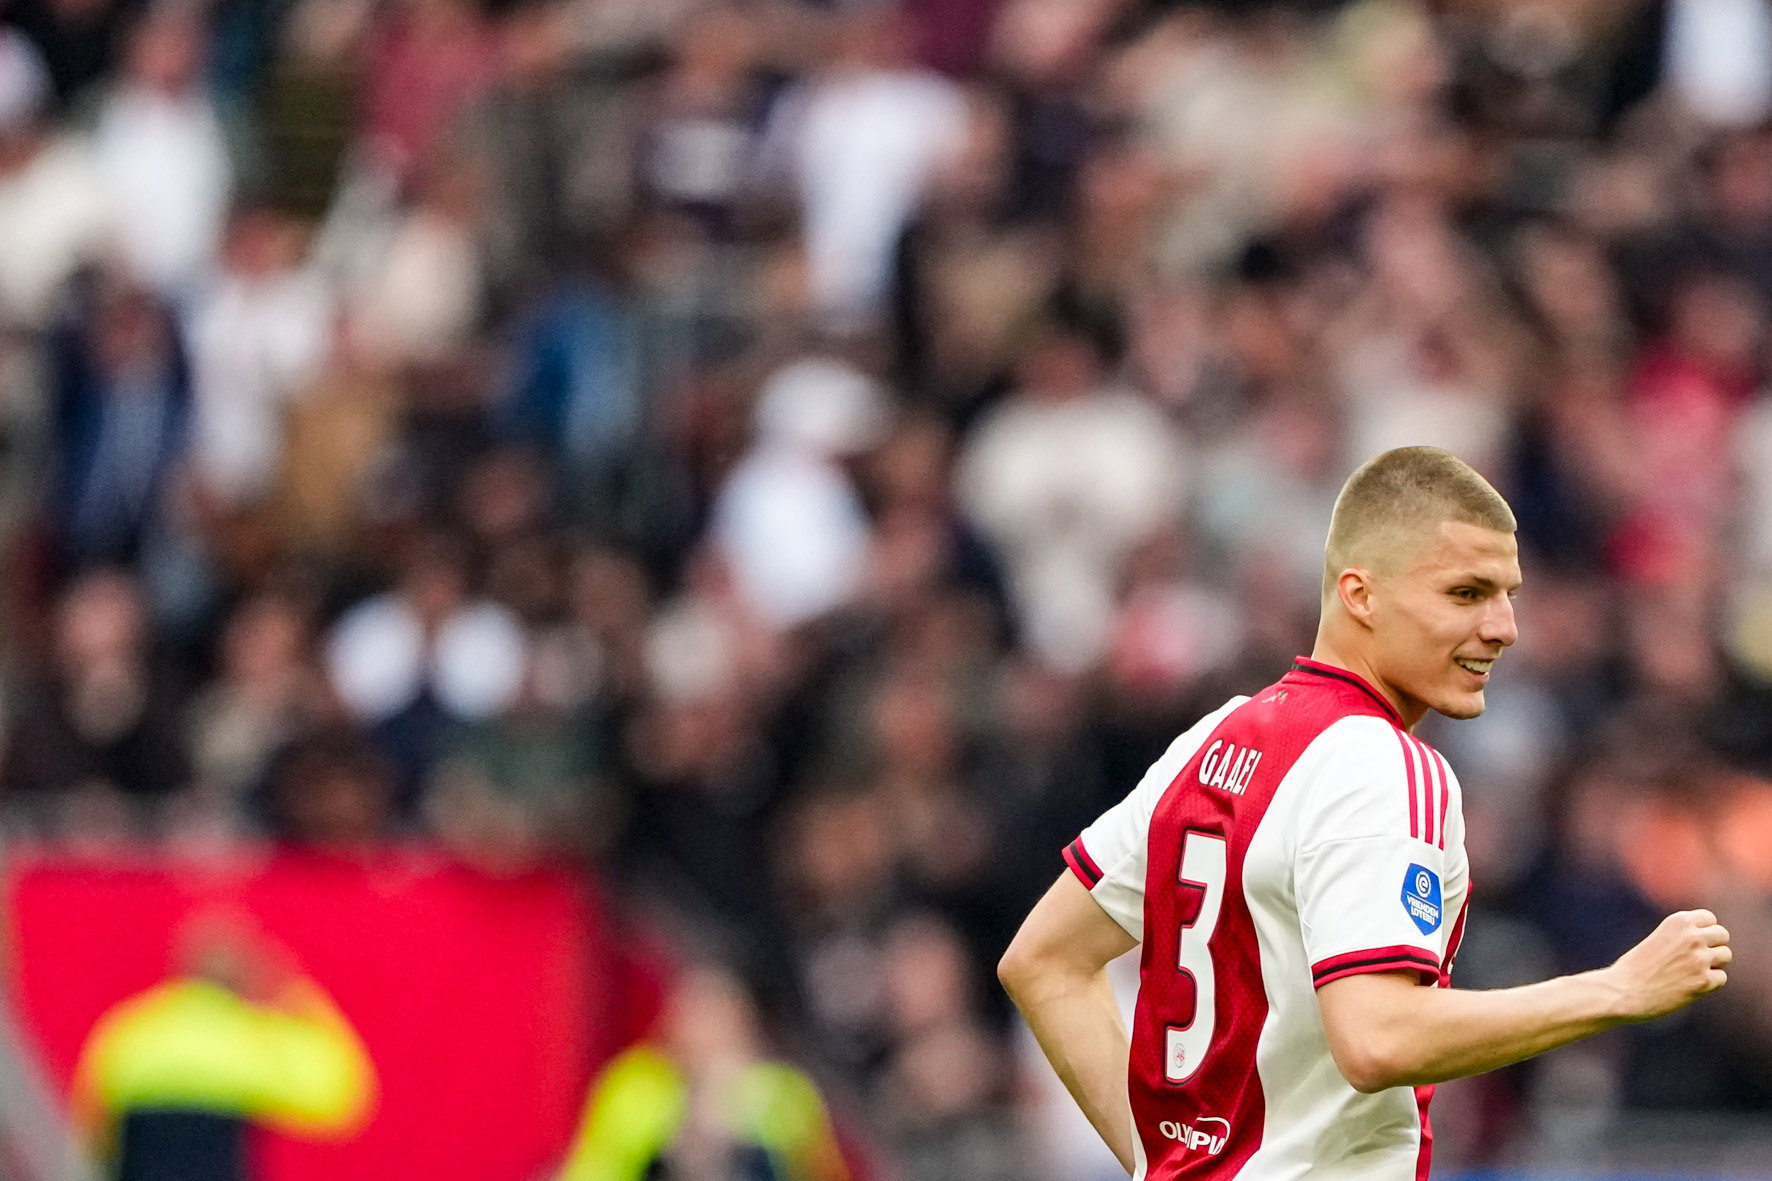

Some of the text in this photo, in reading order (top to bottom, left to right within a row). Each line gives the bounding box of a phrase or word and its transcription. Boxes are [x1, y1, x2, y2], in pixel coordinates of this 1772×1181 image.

[1199, 739, 1263, 796] GAAEI
[1165, 832, 1228, 1084] 3
[1159, 1117, 1231, 1155] OLYPI
